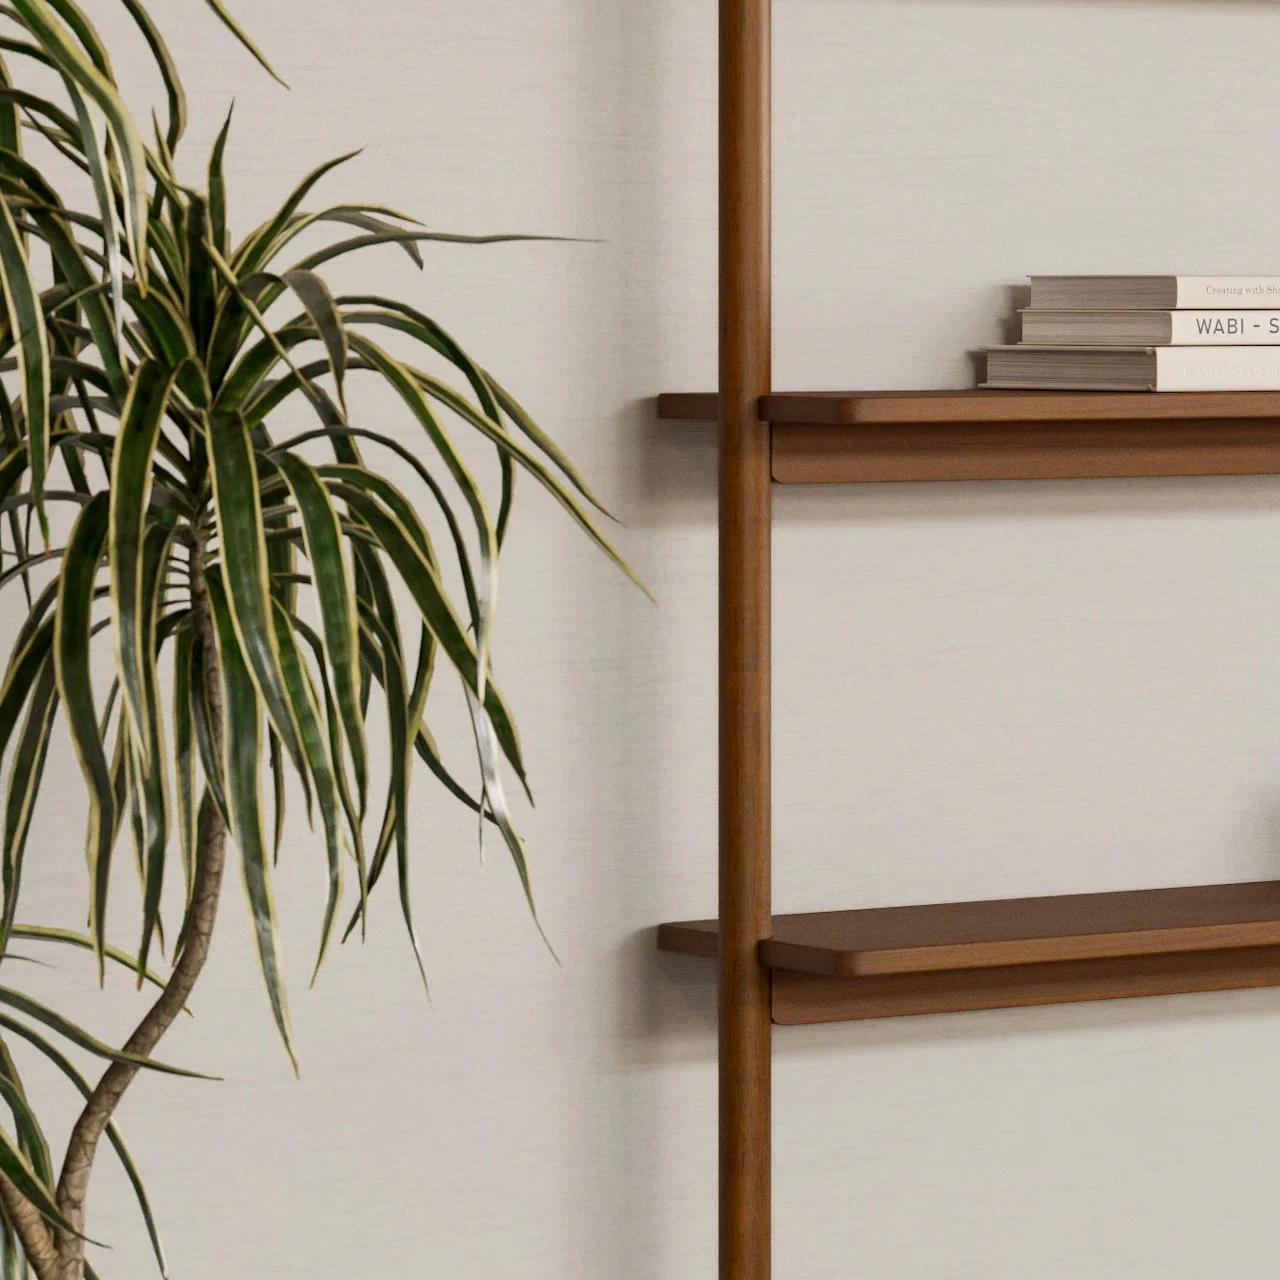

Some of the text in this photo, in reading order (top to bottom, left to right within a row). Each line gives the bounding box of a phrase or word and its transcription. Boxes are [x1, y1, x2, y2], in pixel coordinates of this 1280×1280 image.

[1205, 285, 1243, 296] Creating
[1245, 285, 1265, 295] with
[1196, 318, 1244, 334] WABI
